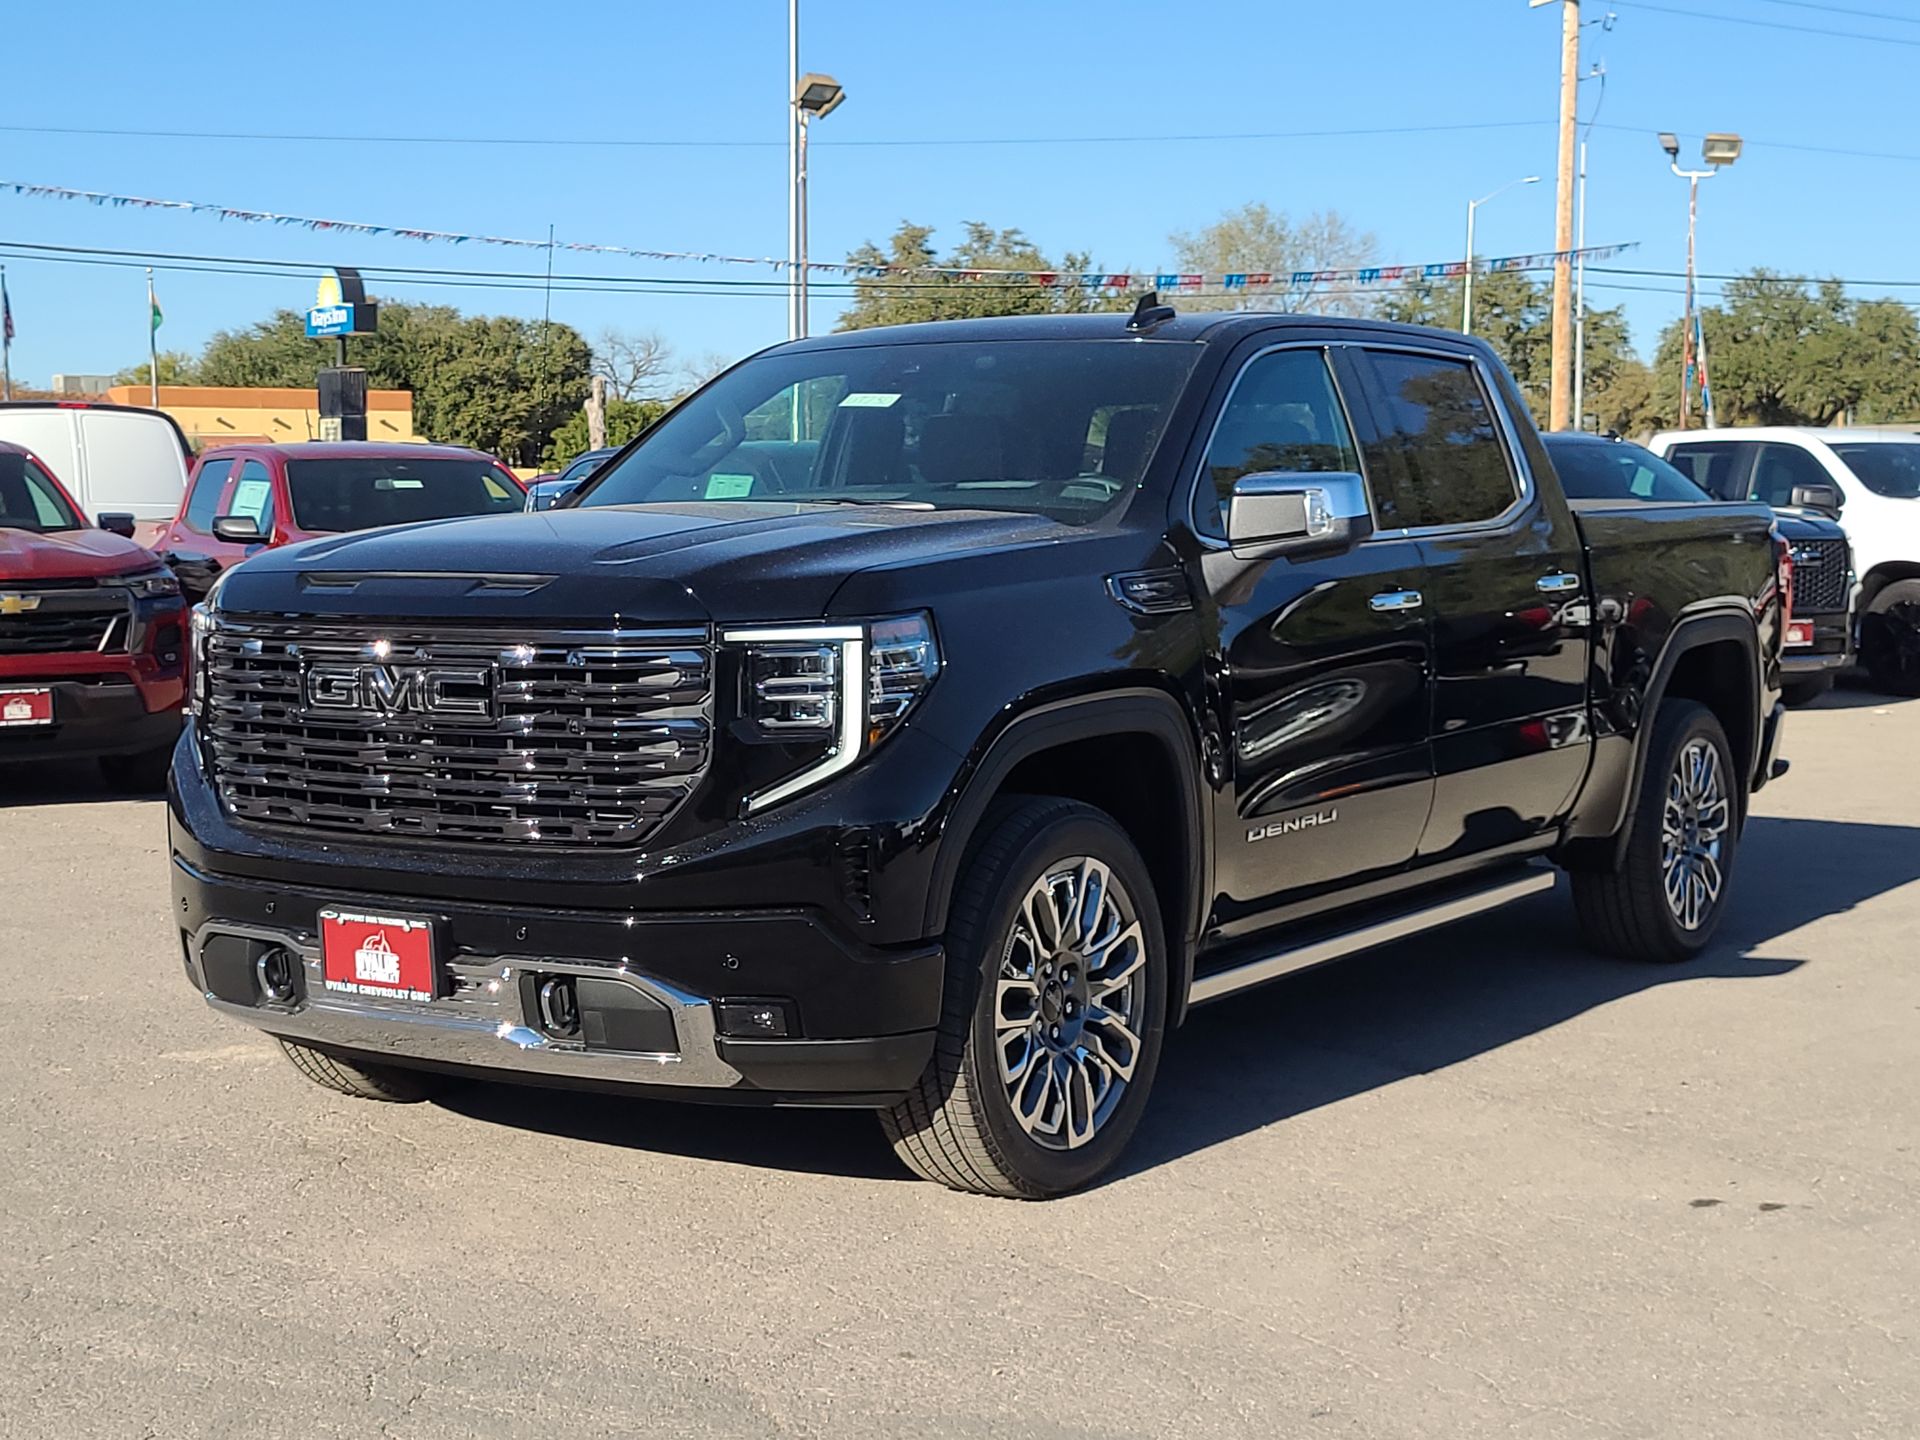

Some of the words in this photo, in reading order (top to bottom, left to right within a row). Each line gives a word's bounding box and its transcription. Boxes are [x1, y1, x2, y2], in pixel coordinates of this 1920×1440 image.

[308, 664, 489, 714] GMC
[1247, 807, 1338, 843] DENALI
[358, 984, 410, 1000] CHEVROLET
[410, 990, 432, 1003] GMC
